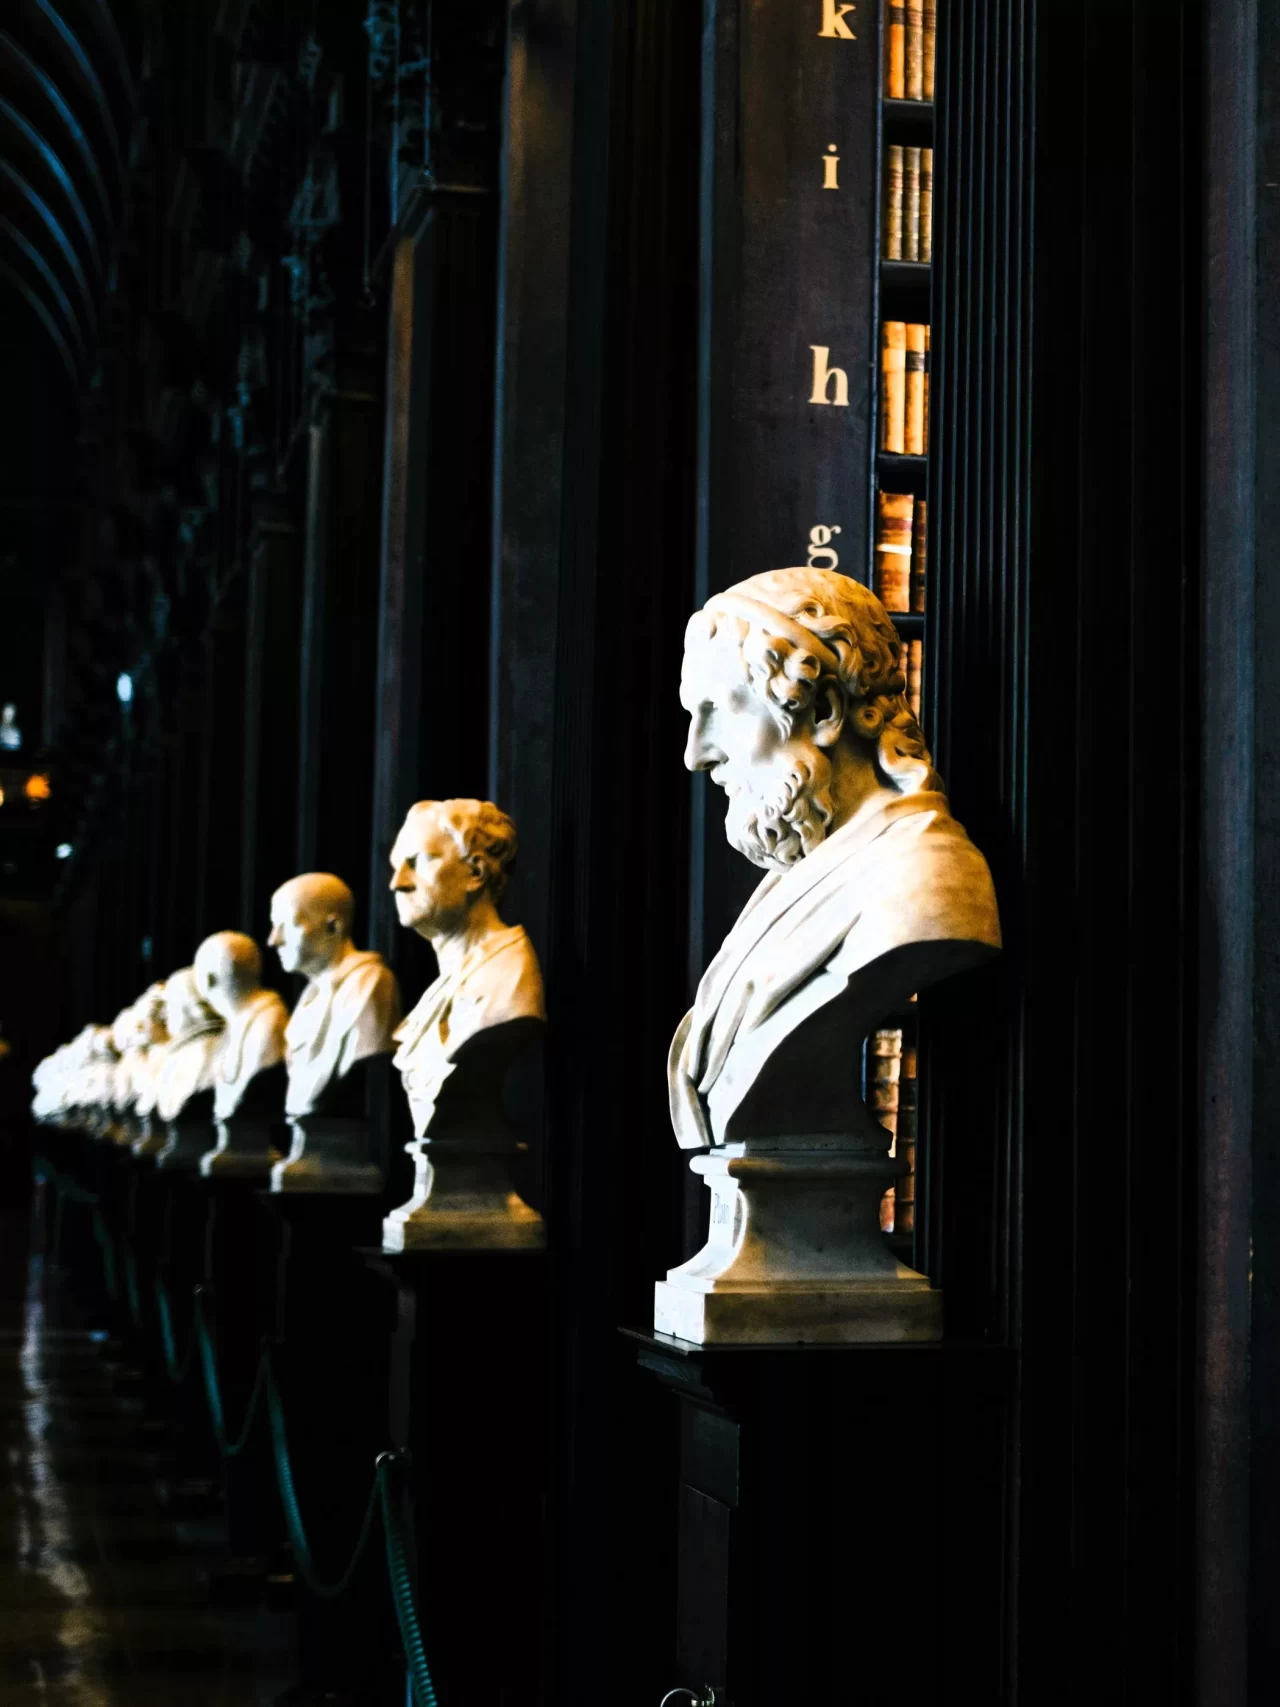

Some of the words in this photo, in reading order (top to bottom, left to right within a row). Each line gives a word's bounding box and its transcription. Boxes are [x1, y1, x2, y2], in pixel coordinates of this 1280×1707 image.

[818, 0, 857, 40] k
[822, 144, 840, 190] i
[808, 345, 850, 407] h
[807, 524, 842, 571] g
